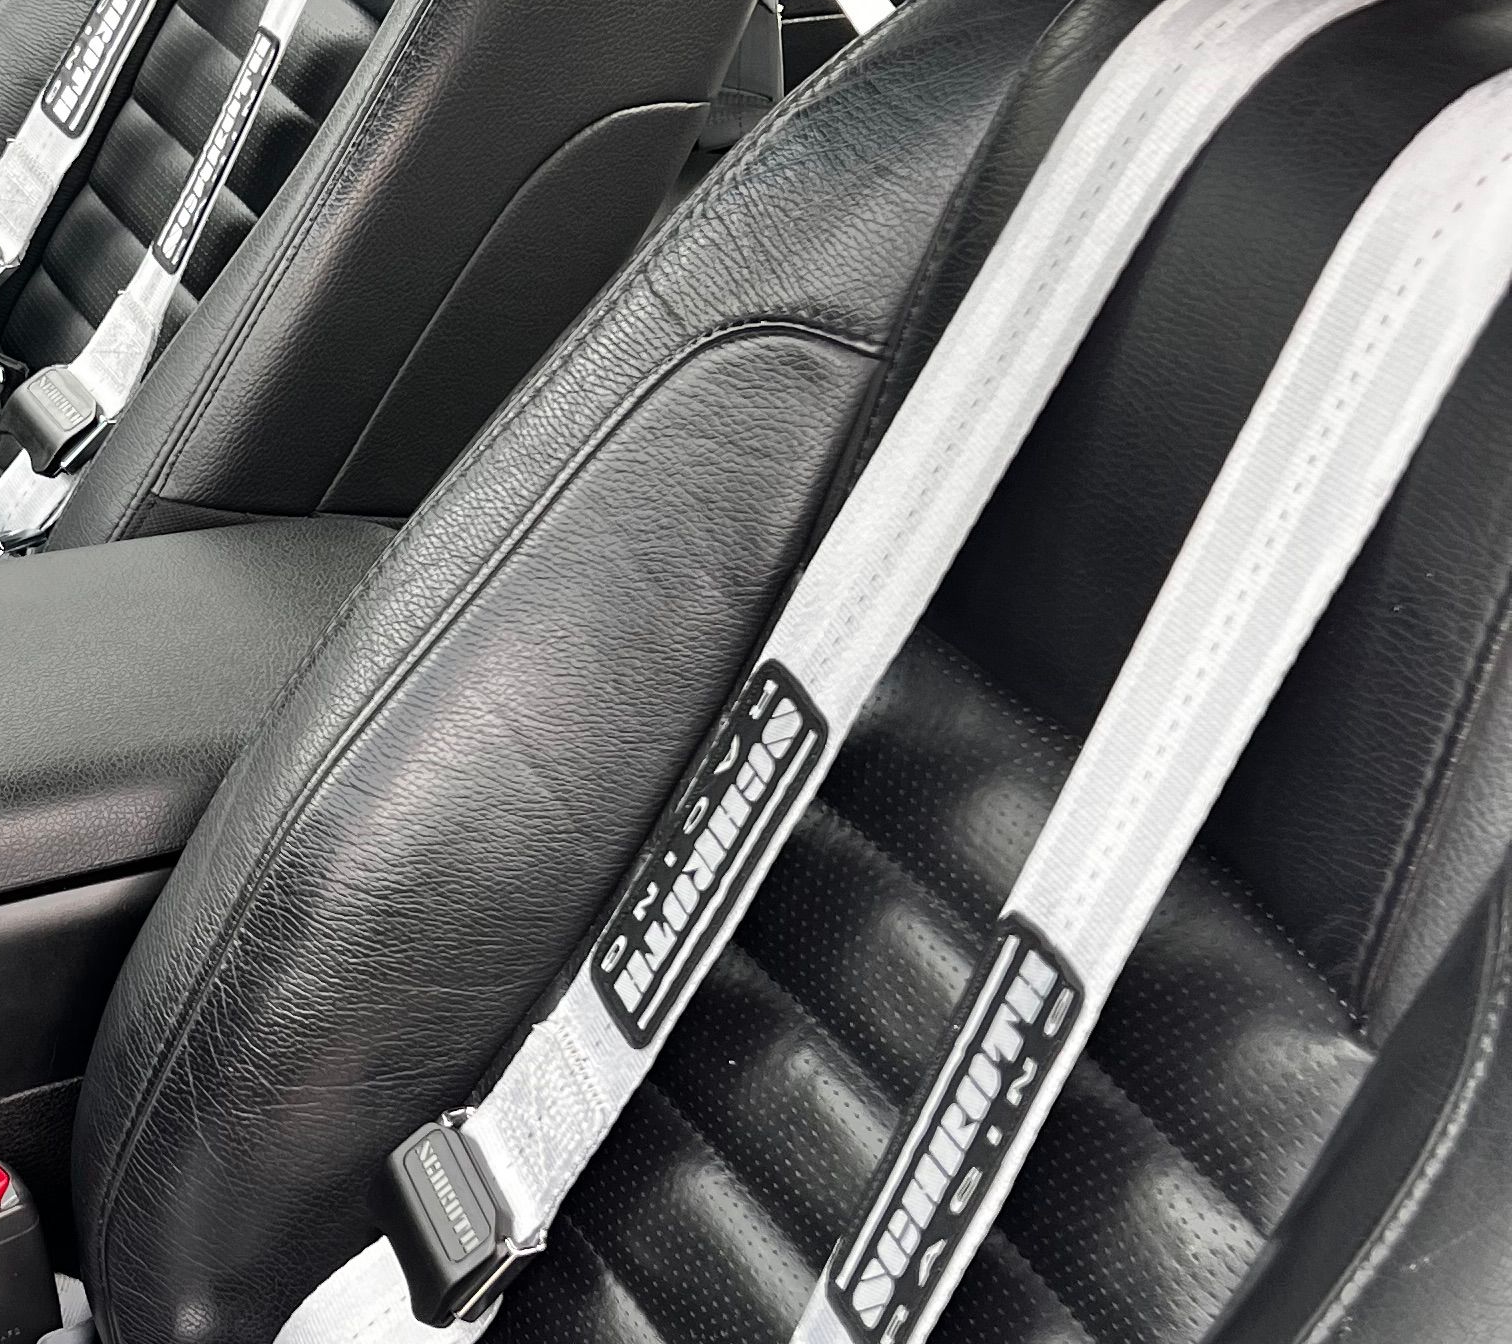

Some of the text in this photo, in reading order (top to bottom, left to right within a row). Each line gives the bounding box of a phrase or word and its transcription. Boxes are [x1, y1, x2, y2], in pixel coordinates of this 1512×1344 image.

[161, 35, 271, 259] SCHROTH
[598, 678, 778, 973] RACING
[612, 694, 805, 1013] SCHROTH
[851, 947, 1058, 1329] SCHROTH
